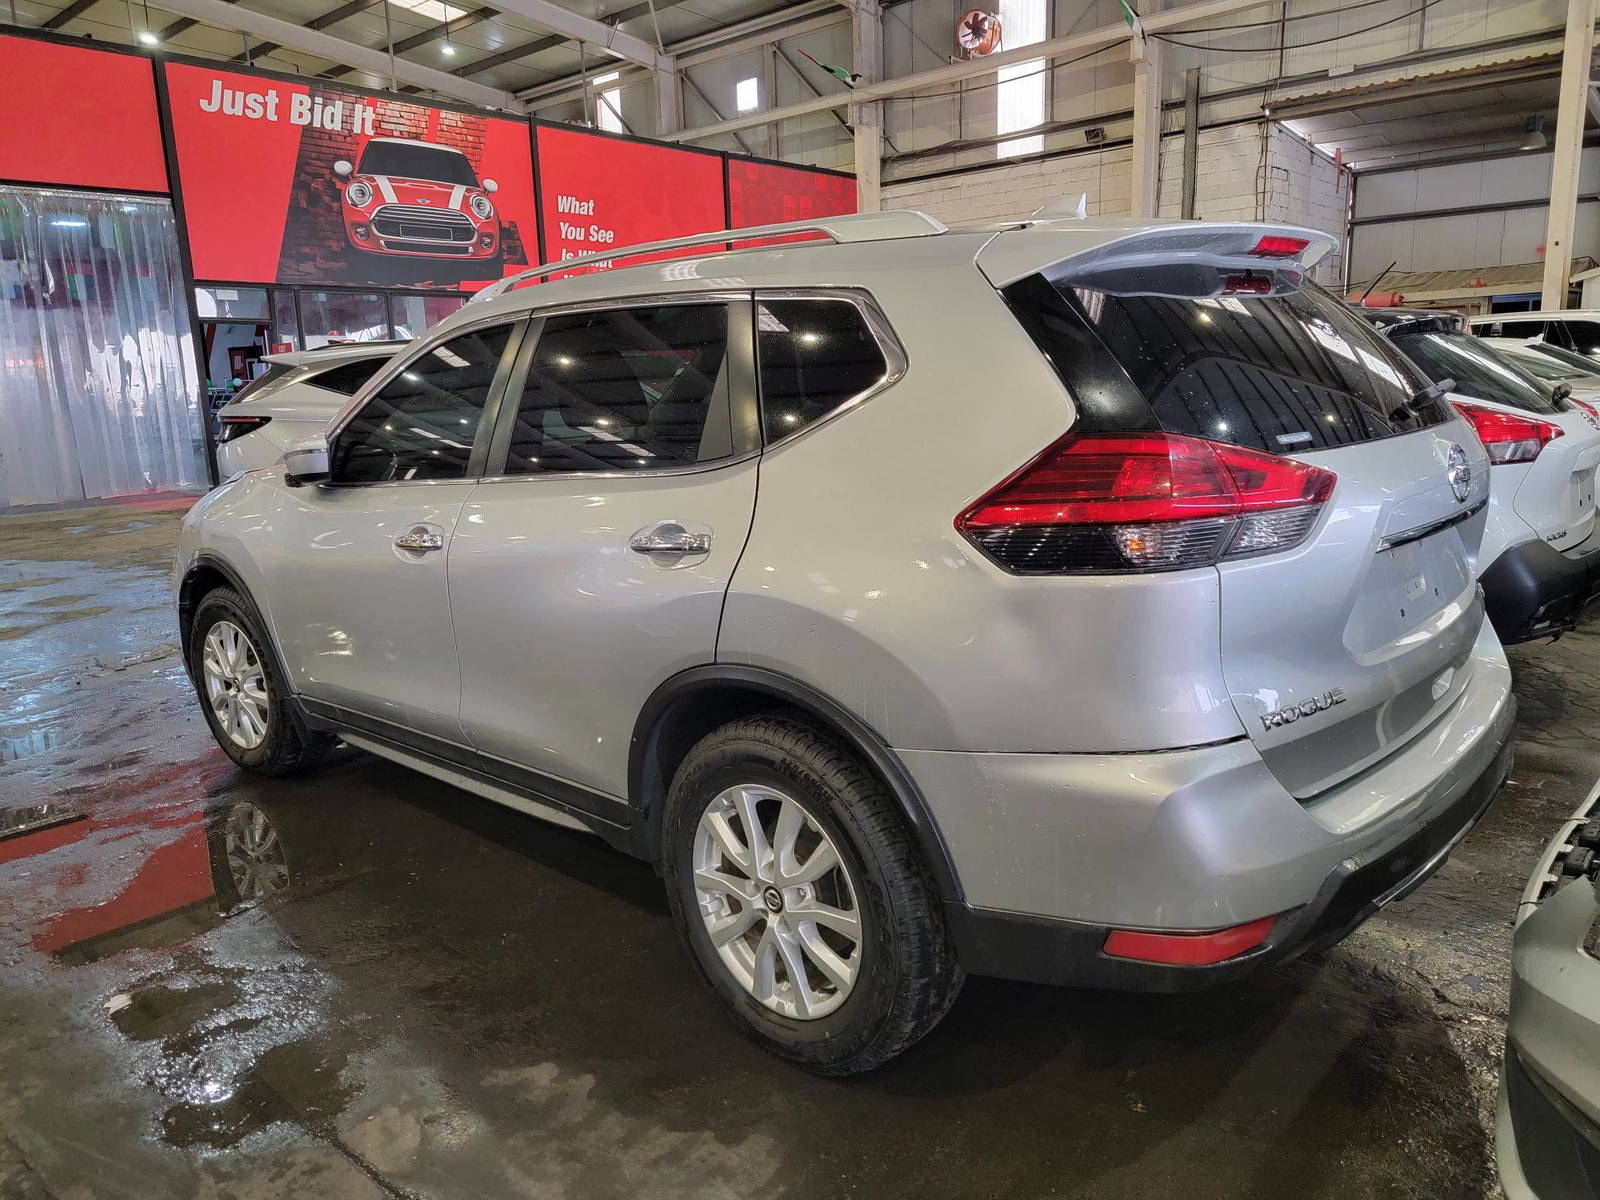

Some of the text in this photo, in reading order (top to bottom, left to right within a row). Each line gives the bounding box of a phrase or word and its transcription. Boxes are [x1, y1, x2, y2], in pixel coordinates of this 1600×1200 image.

[200, 80, 375, 135] Just Bid It
[557, 195, 595, 216] What
[560, 221, 615, 243] You See
[1259, 687, 1347, 732] ROGUE
